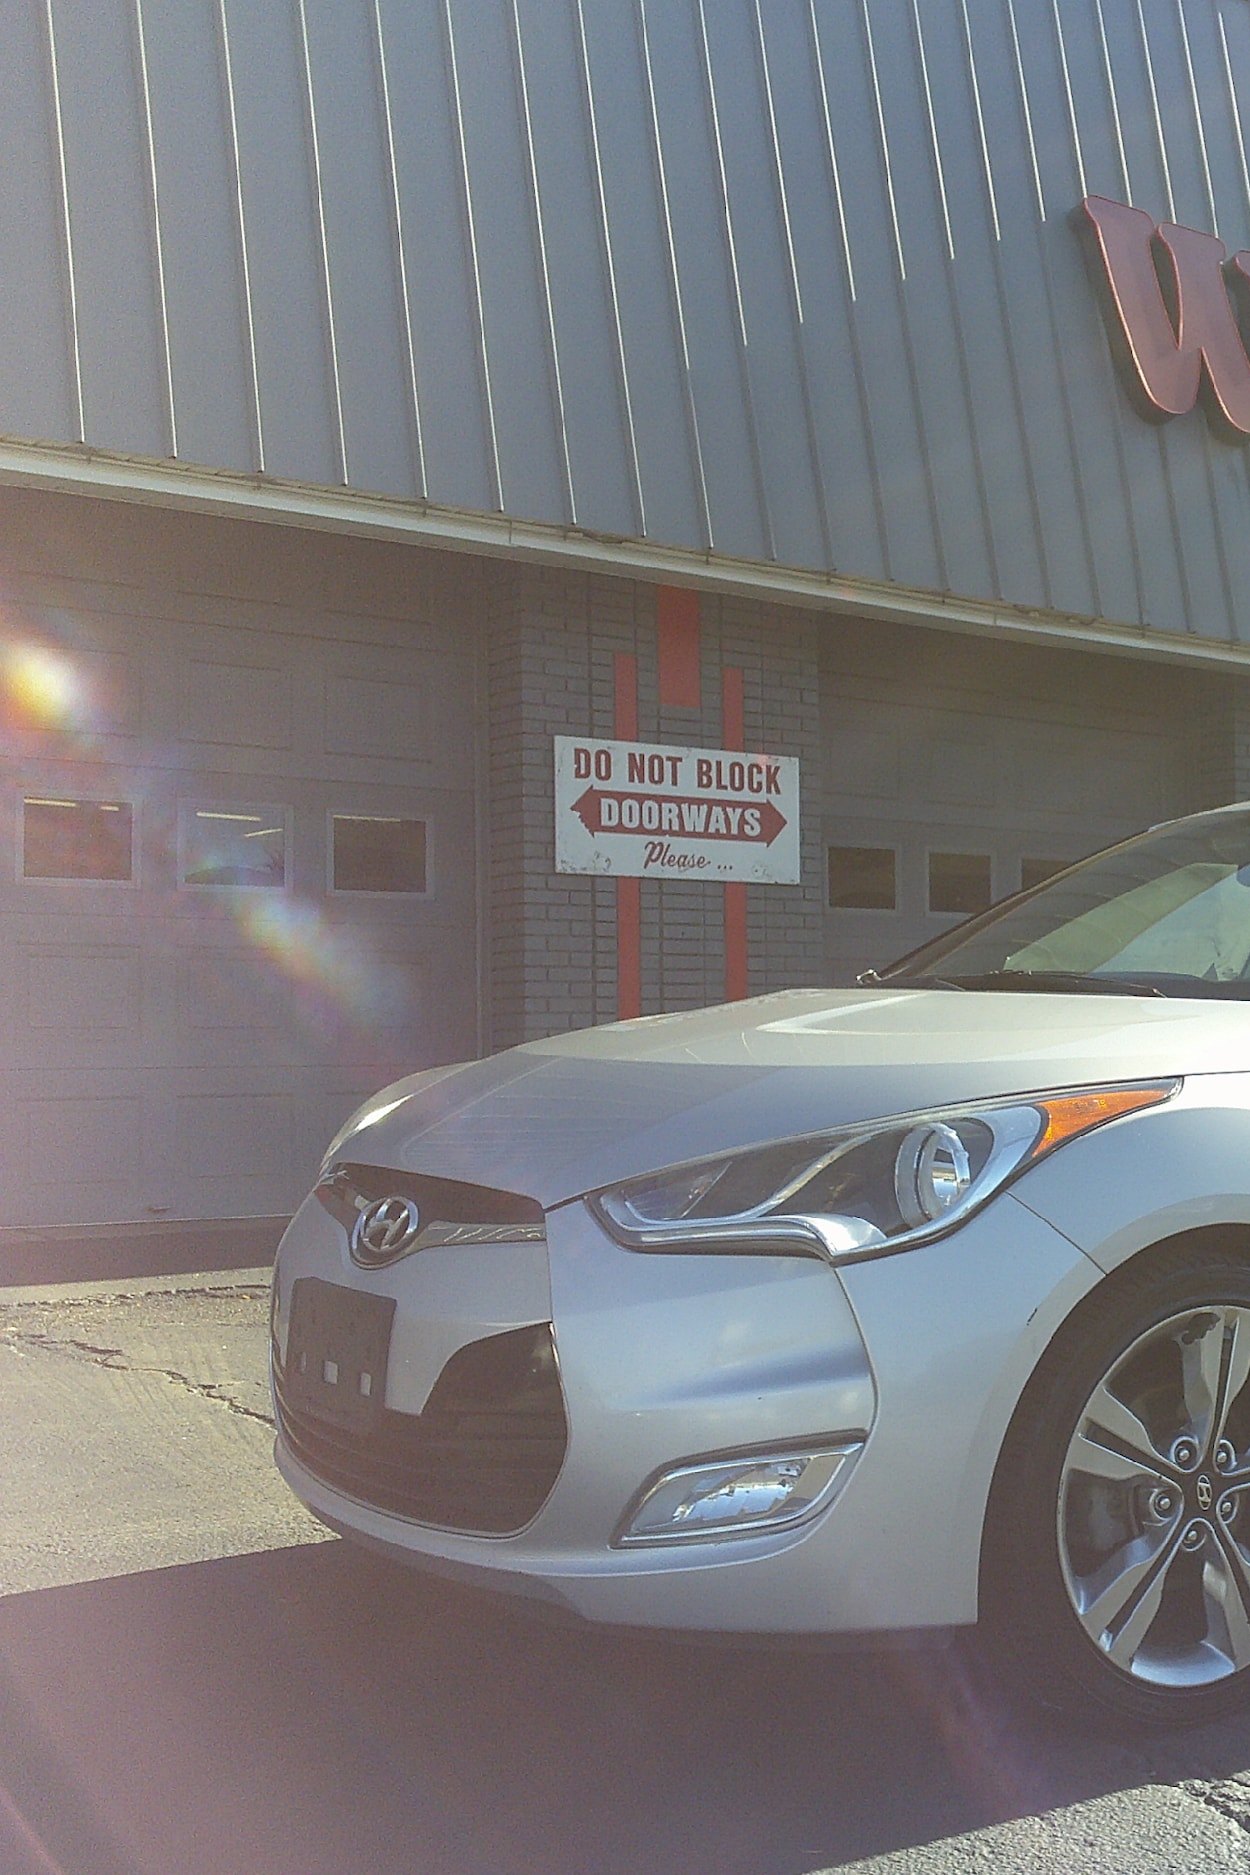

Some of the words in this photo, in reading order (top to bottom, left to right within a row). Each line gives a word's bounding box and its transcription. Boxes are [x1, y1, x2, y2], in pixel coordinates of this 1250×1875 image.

[573, 747, 612, 781] DO
[627, 751, 683, 787] NOT
[696, 758, 782, 795] BLOCK
[600, 797, 762, 837] DOORWAYS
